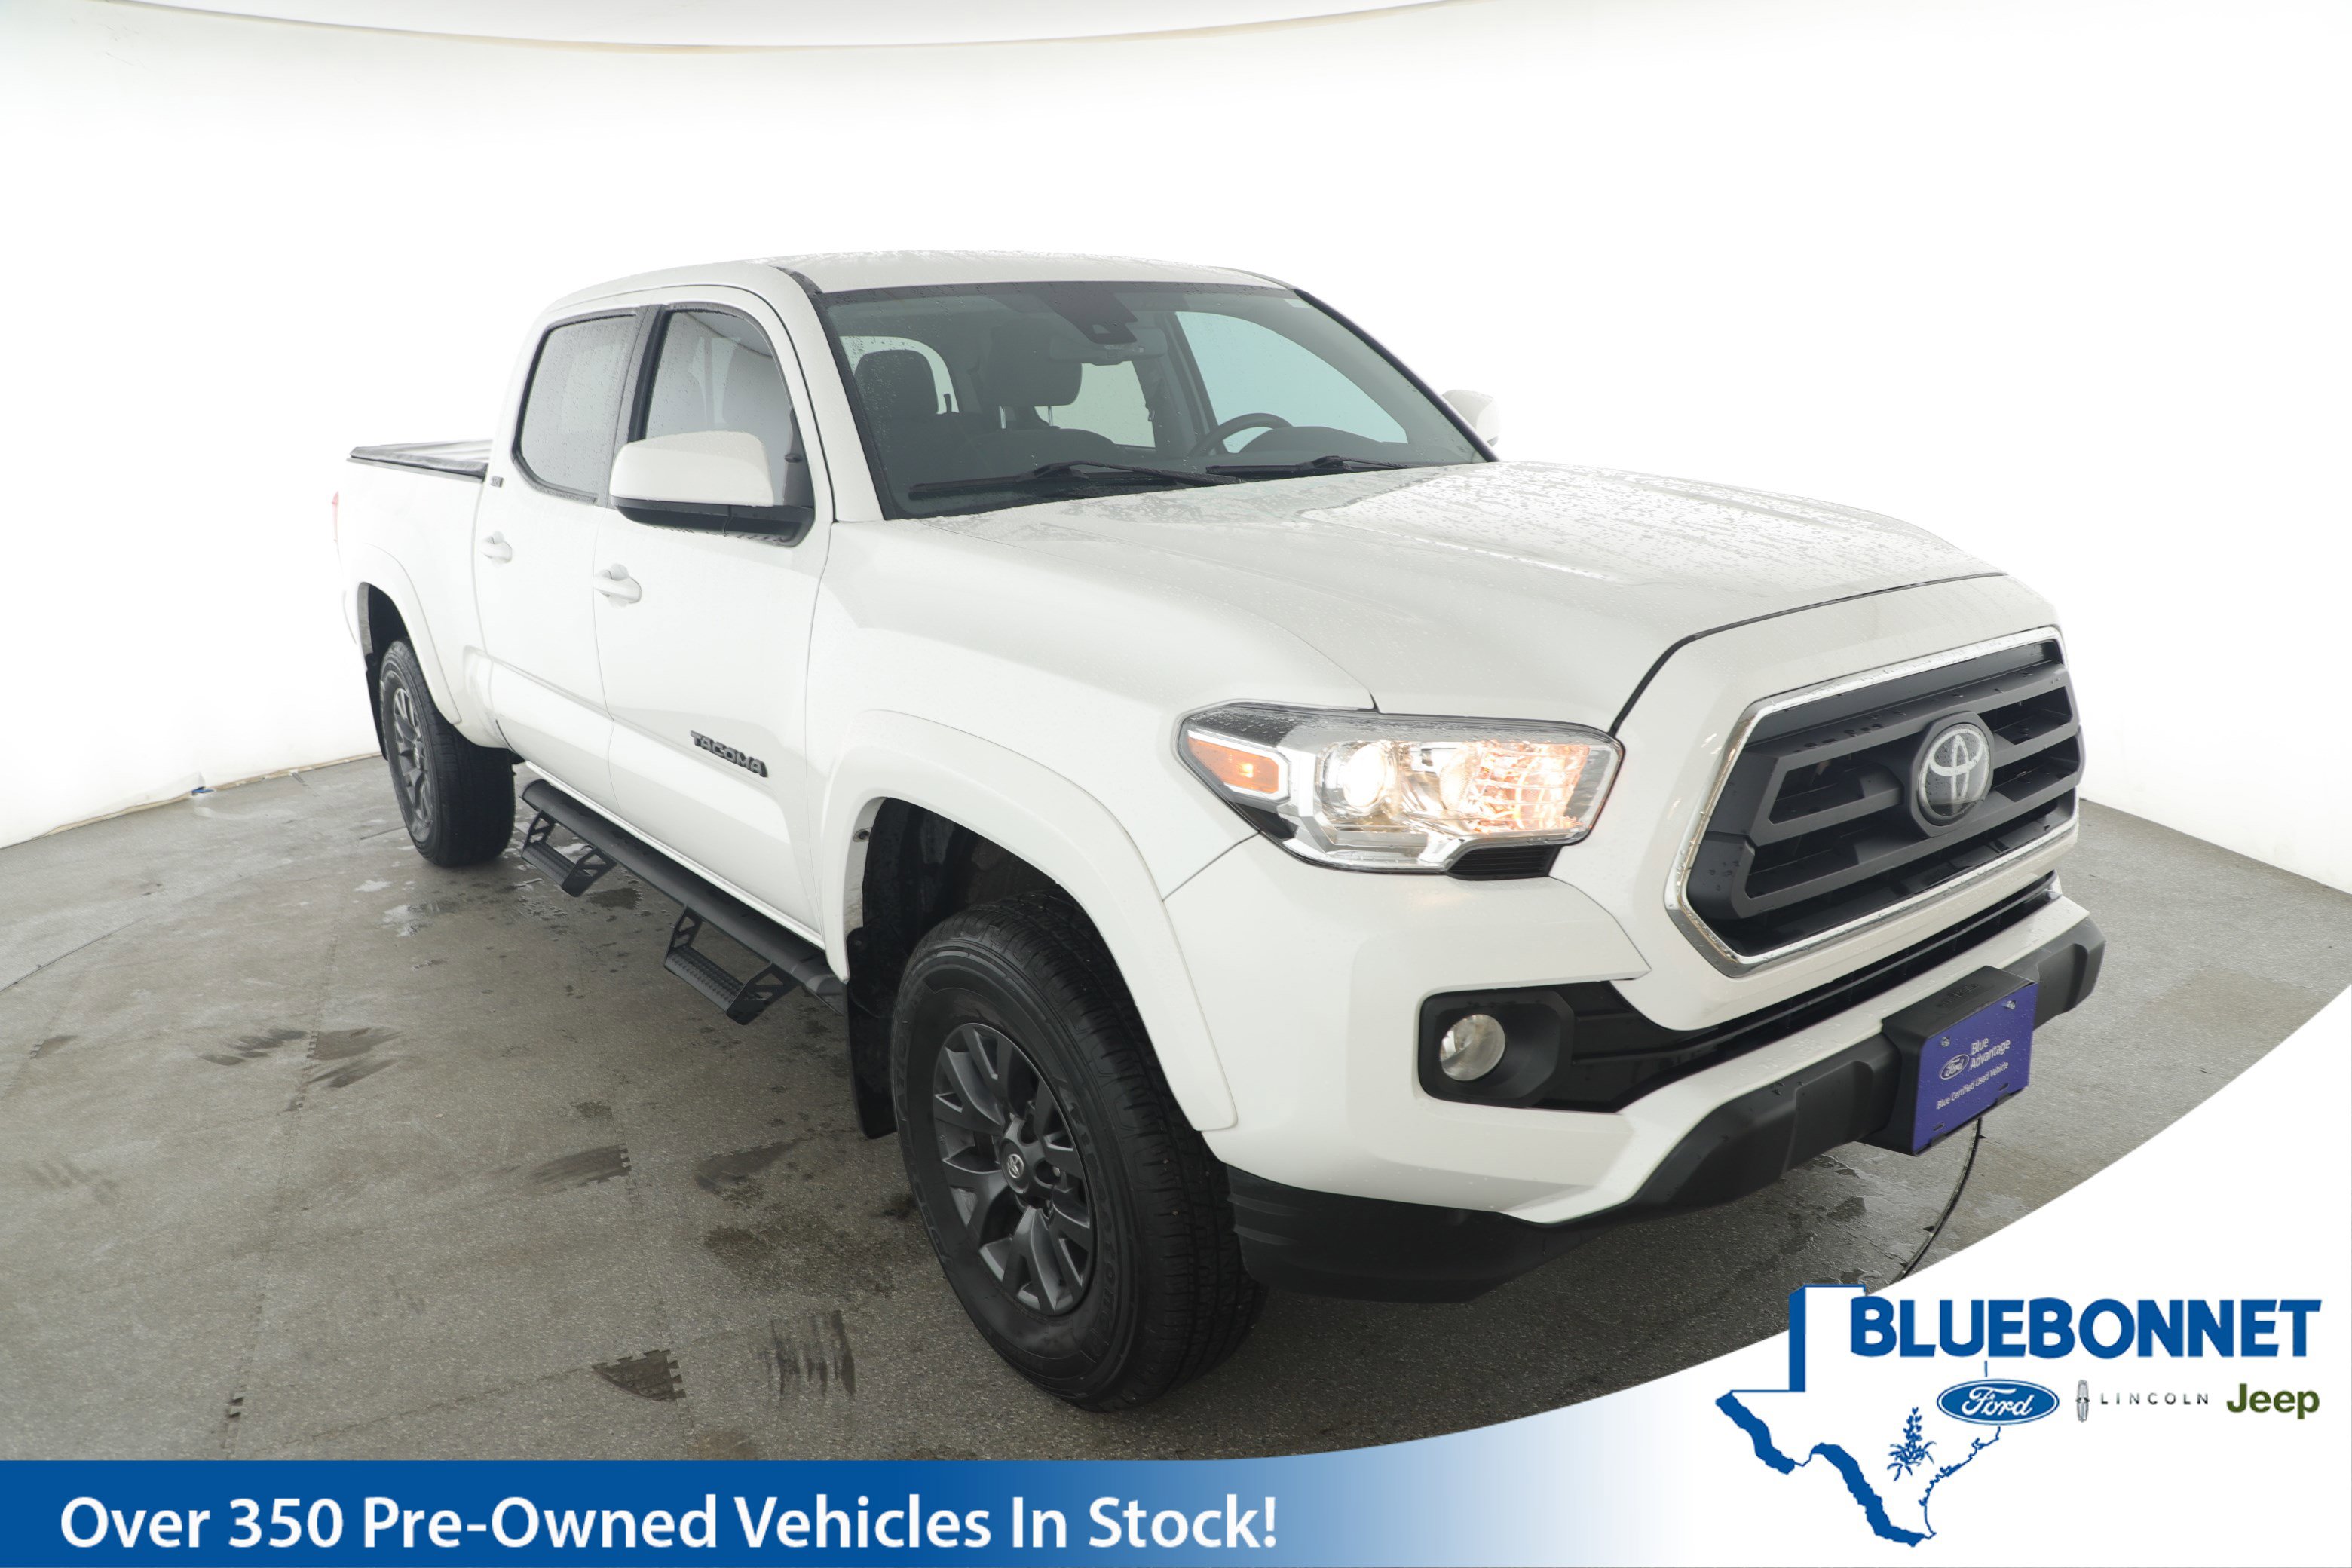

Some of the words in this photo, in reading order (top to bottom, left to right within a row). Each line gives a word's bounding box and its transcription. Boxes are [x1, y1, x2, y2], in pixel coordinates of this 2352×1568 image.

[690, 730, 769, 778] TACOMA
[1969, 1039, 2011, 1071] Advantage
[1971, 1037, 1989, 1055] Blue
[1944, 1058, 1965, 1077] Ford
[1936, 1097, 1951, 1110] Blue
[1951, 1080, 1975, 1101] Certified
[1975, 1071, 1989, 1086] Used
[1990, 1061, 2009, 1077] Vehicle
